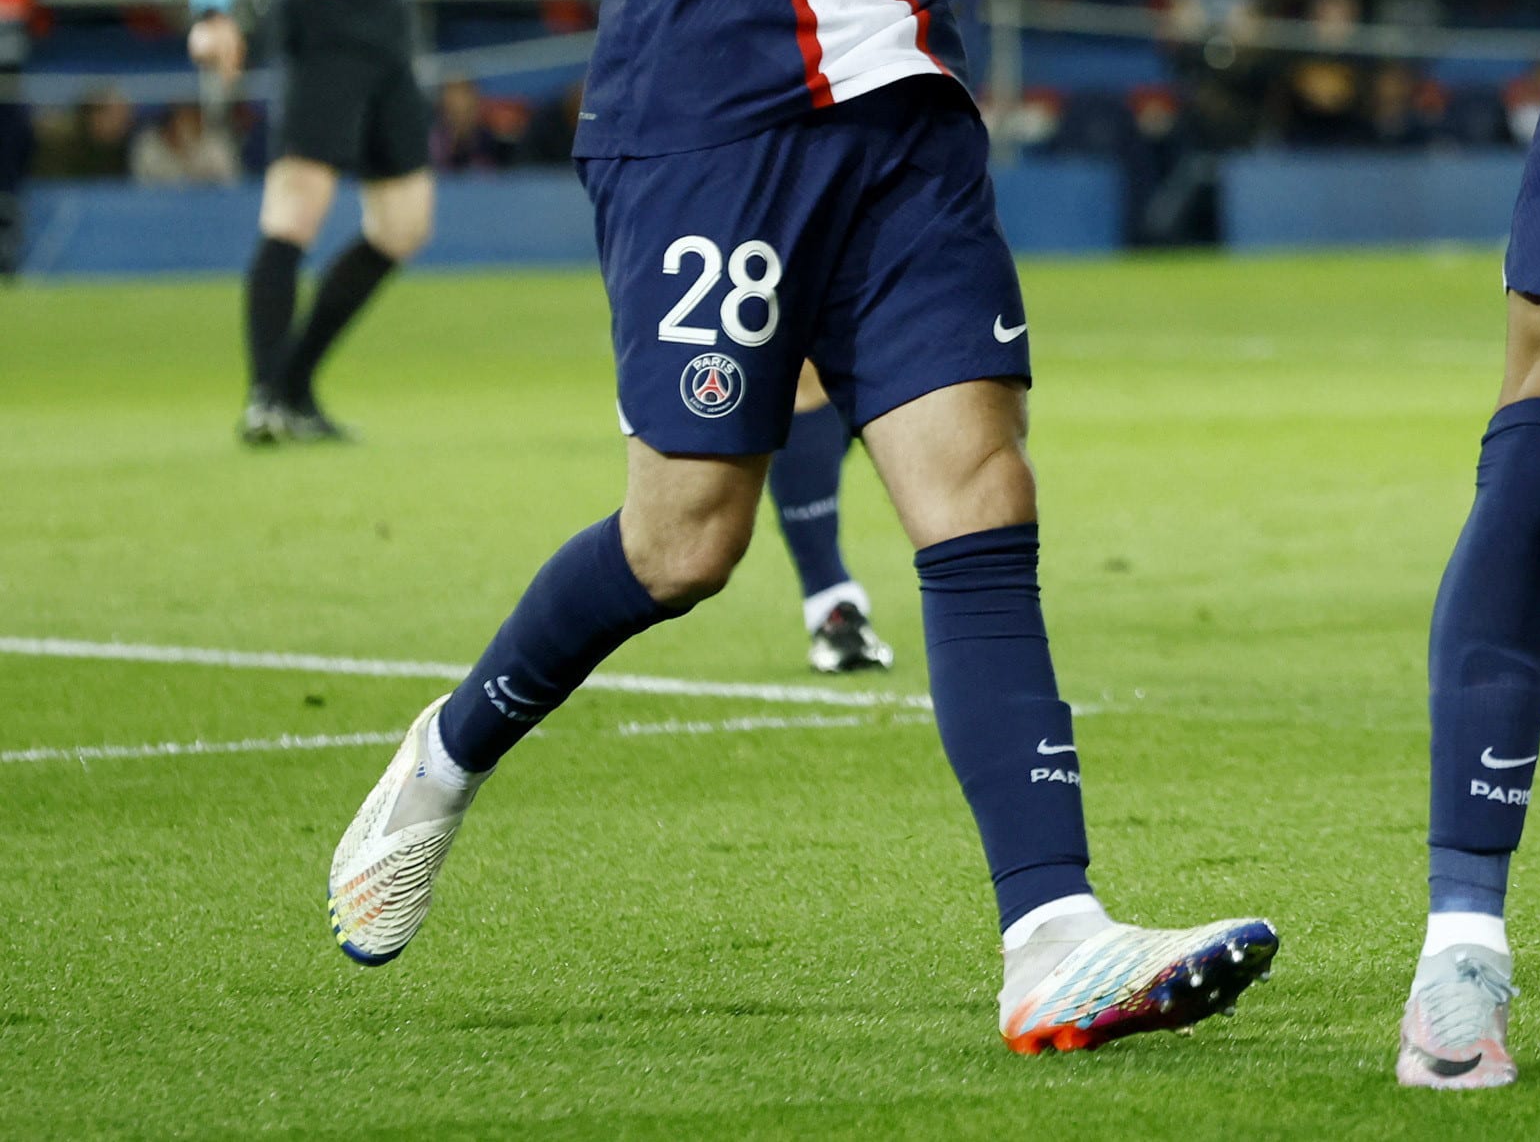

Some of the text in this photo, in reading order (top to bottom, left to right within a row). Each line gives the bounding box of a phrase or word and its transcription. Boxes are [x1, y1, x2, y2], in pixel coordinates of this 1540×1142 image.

[658, 235, 783, 347] 28
[692, 356, 735, 374] PARIS
[1030, 767, 1080, 786] PAR
